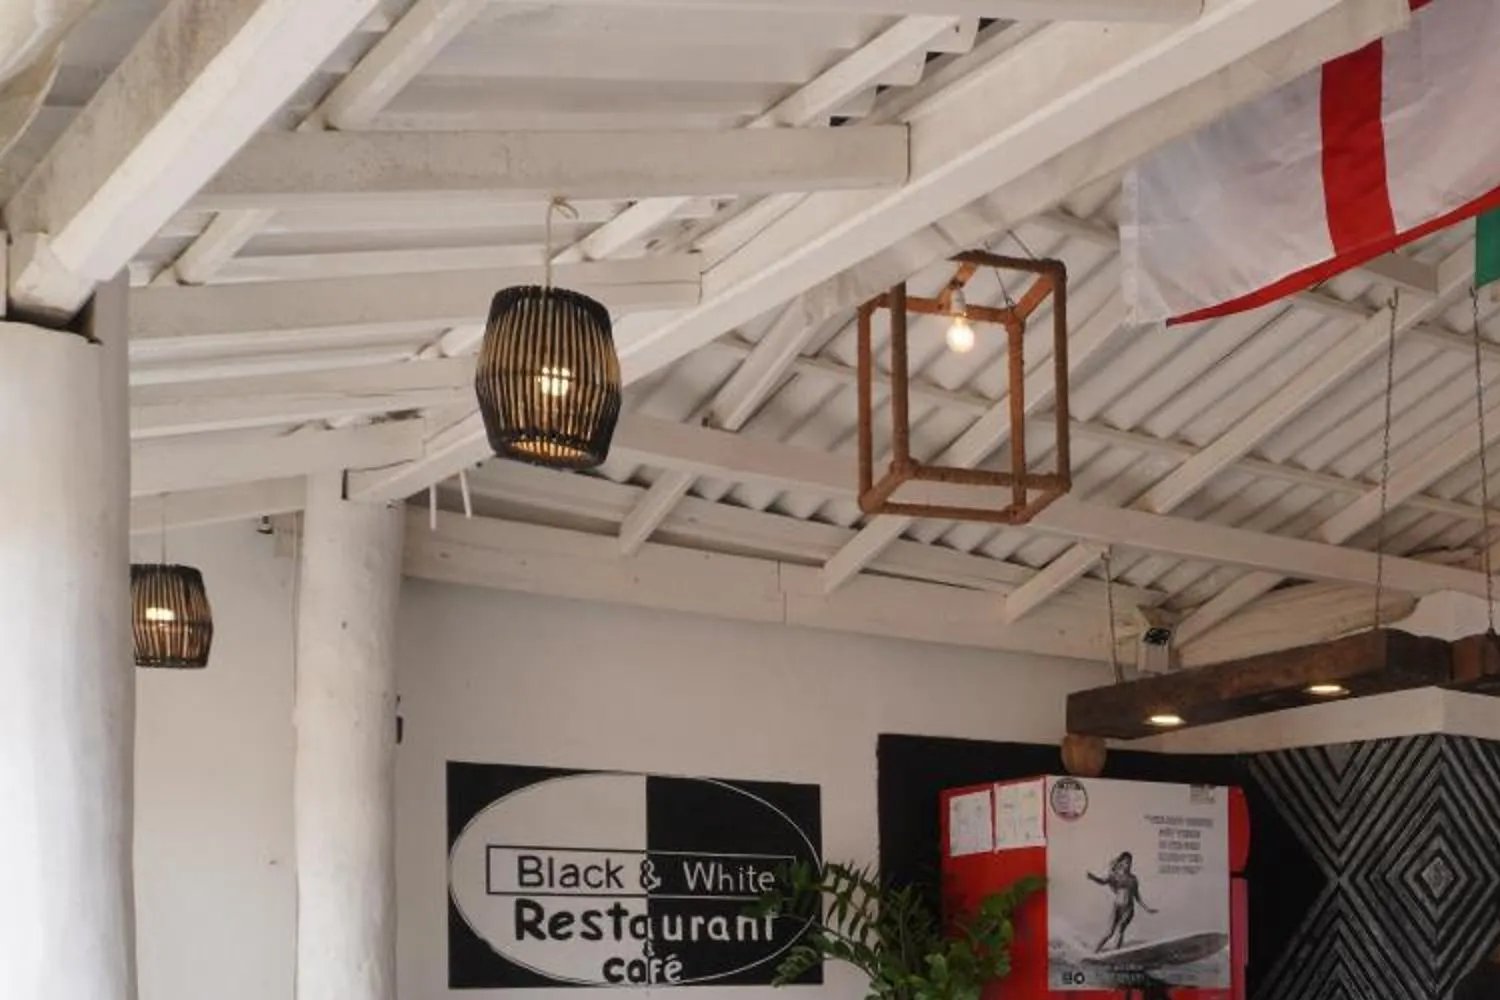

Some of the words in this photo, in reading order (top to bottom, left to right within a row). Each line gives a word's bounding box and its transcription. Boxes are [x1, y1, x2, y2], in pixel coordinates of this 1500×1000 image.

[517, 855, 624, 889] Black
[640, 859, 662, 890] &
[683, 861, 776, 893] White
[515, 898, 779, 942] Restaurant
